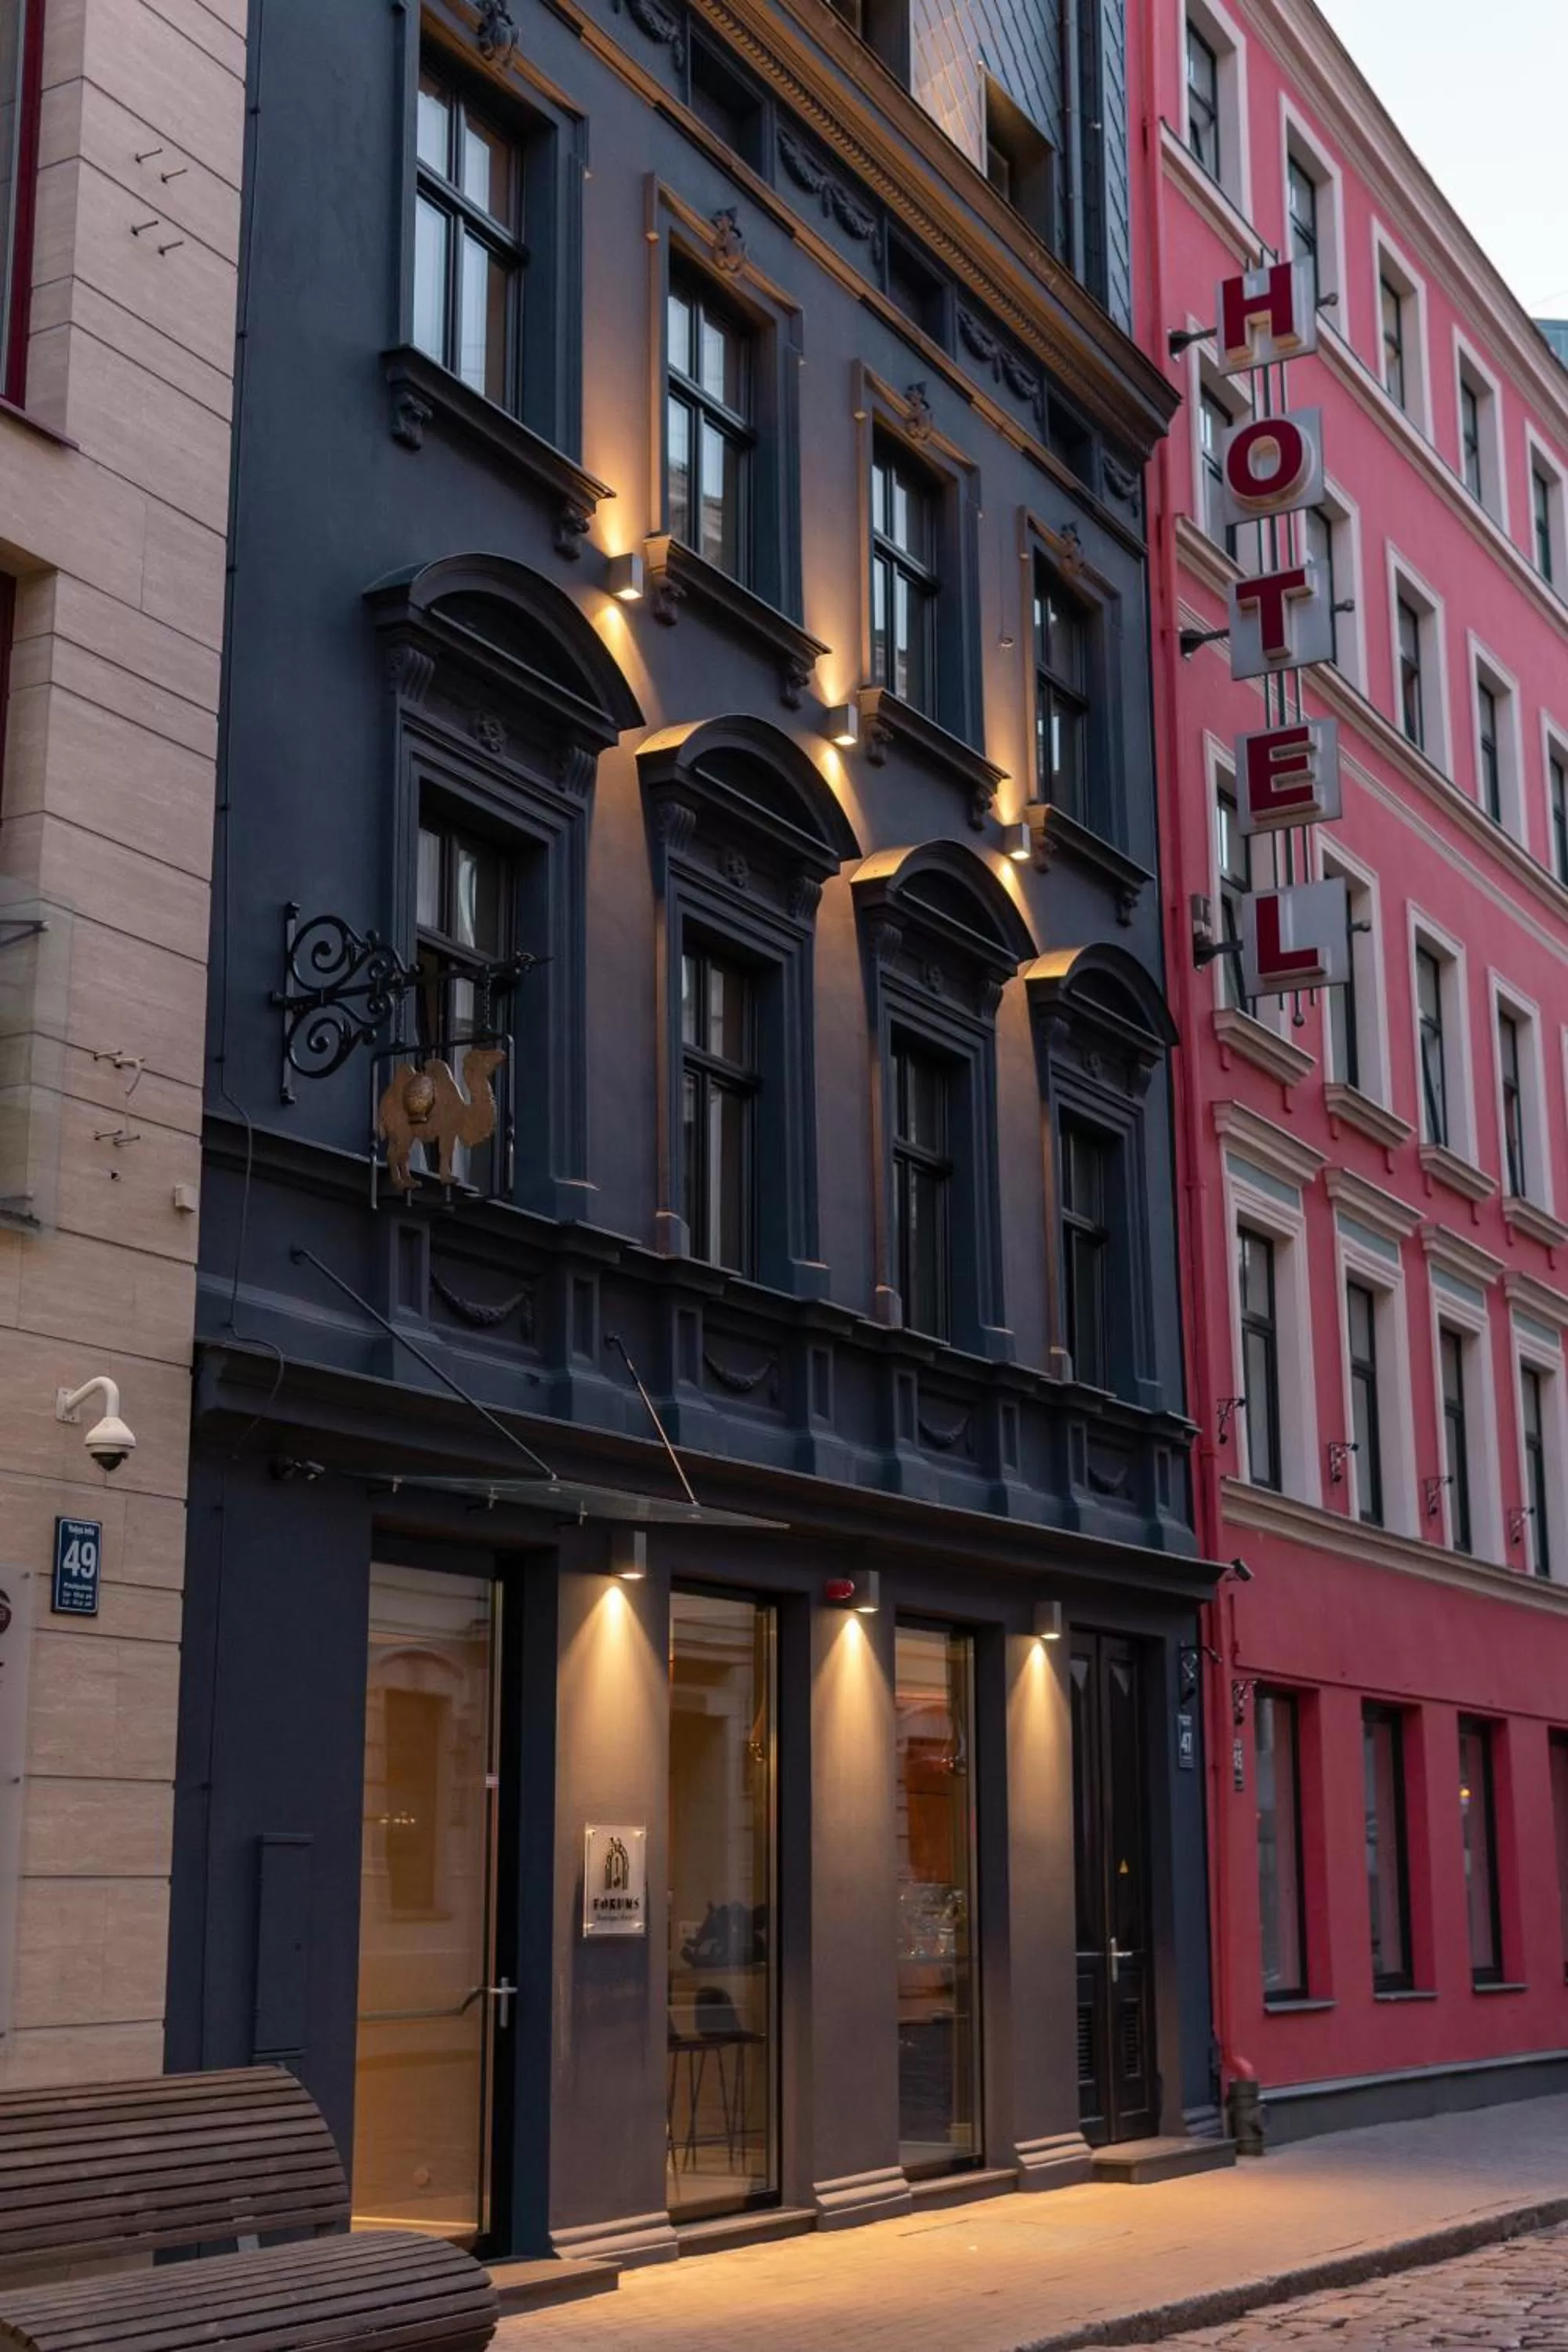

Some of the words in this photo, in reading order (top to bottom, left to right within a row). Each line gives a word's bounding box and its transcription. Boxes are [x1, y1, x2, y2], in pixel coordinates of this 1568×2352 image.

[1221, 263, 1323, 977] HOTEL
[63, 1539, 96, 1579] 49
[1181, 1732, 1192, 1753] 47
